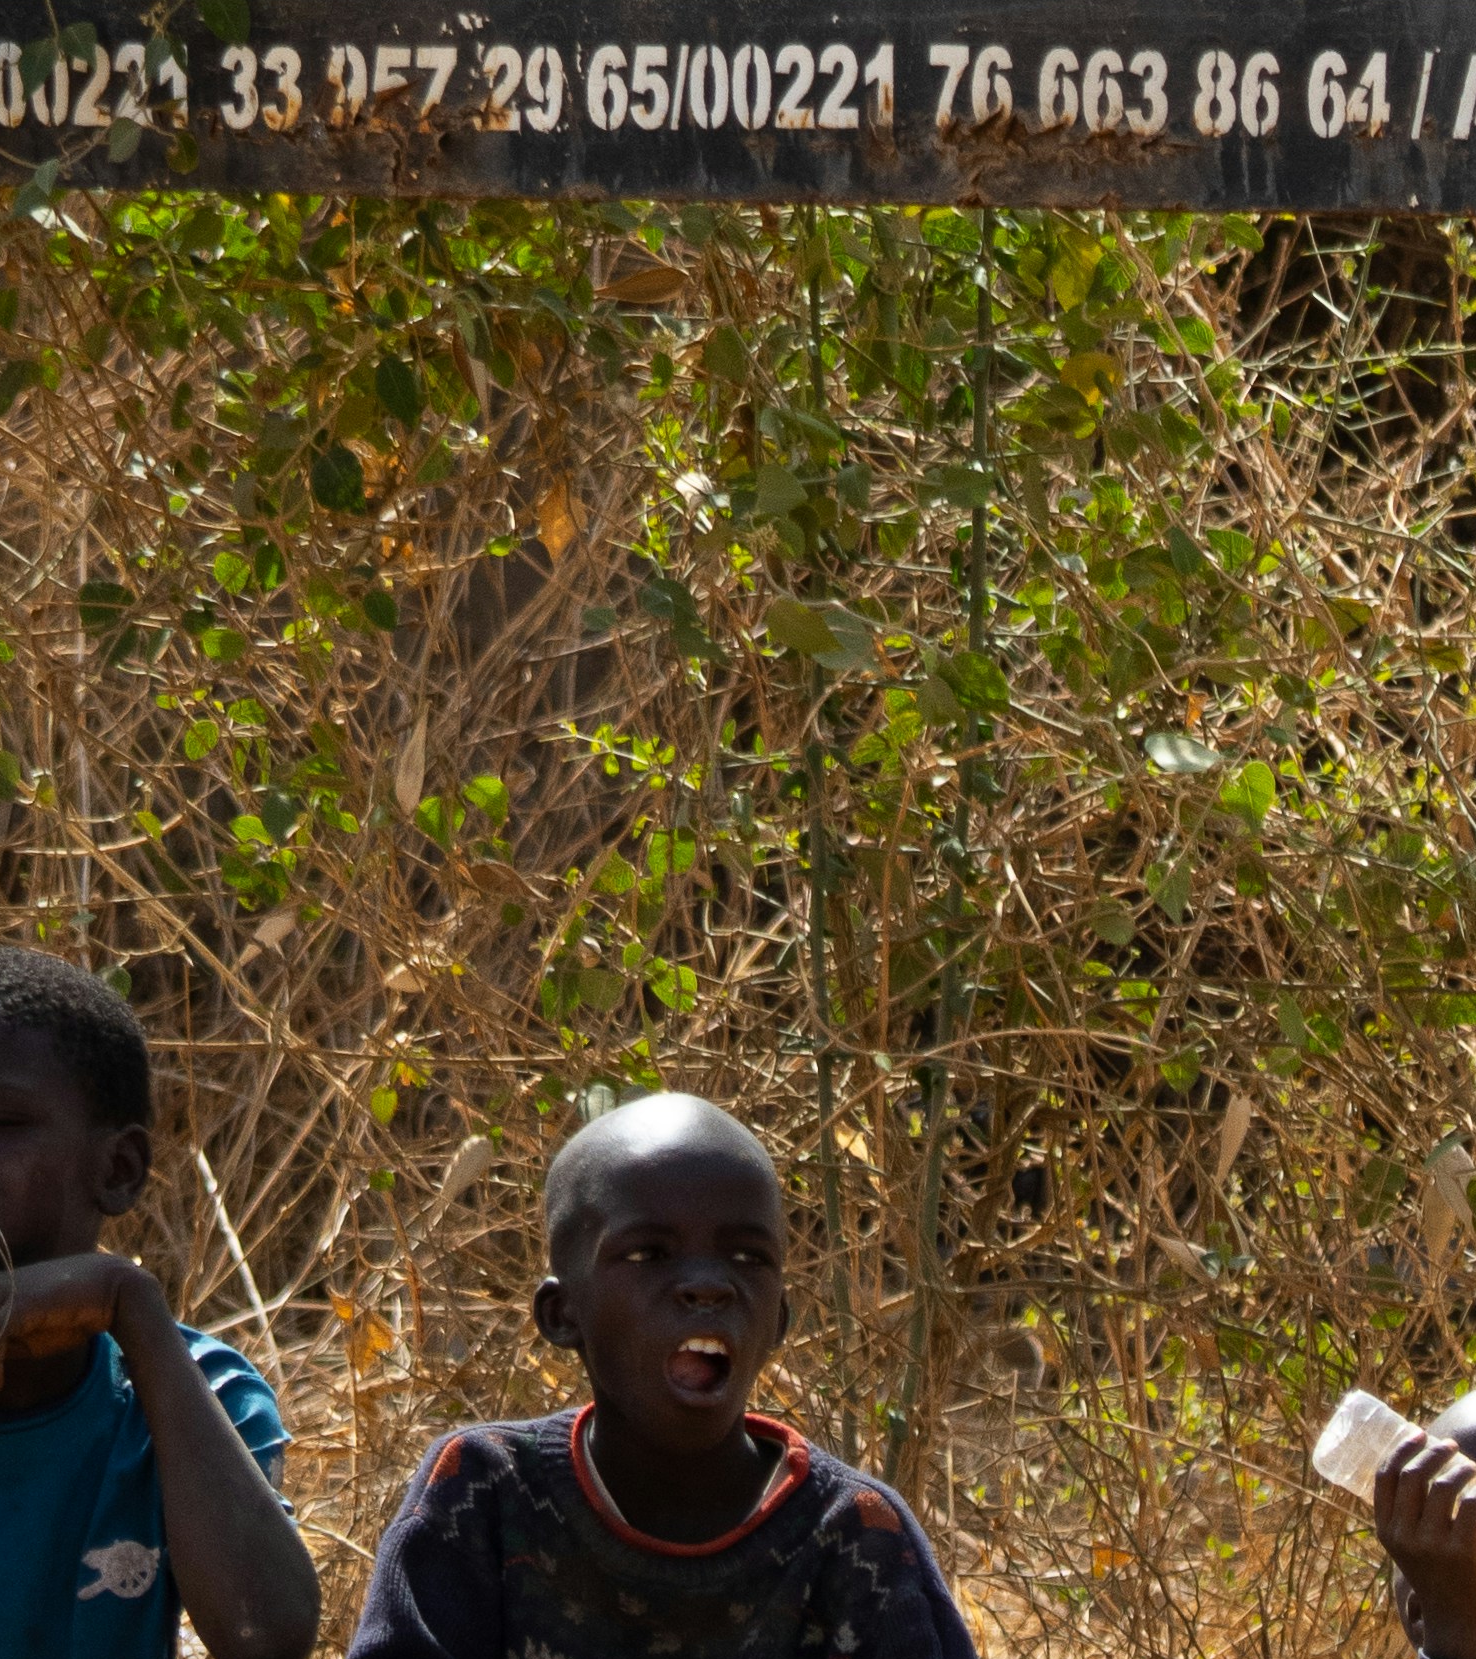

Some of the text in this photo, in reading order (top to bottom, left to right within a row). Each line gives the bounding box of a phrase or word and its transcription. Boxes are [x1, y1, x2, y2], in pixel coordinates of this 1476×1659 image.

[220, 44, 303, 131] 33
[477, 45, 564, 132] 29
[586, 44, 895, 131] 65/00221
[929, 44, 1015, 137] 76
[1037, 47, 1170, 135] 663
[1193, 49, 1281, 138] 86
[1306, 50, 1392, 140] 64
